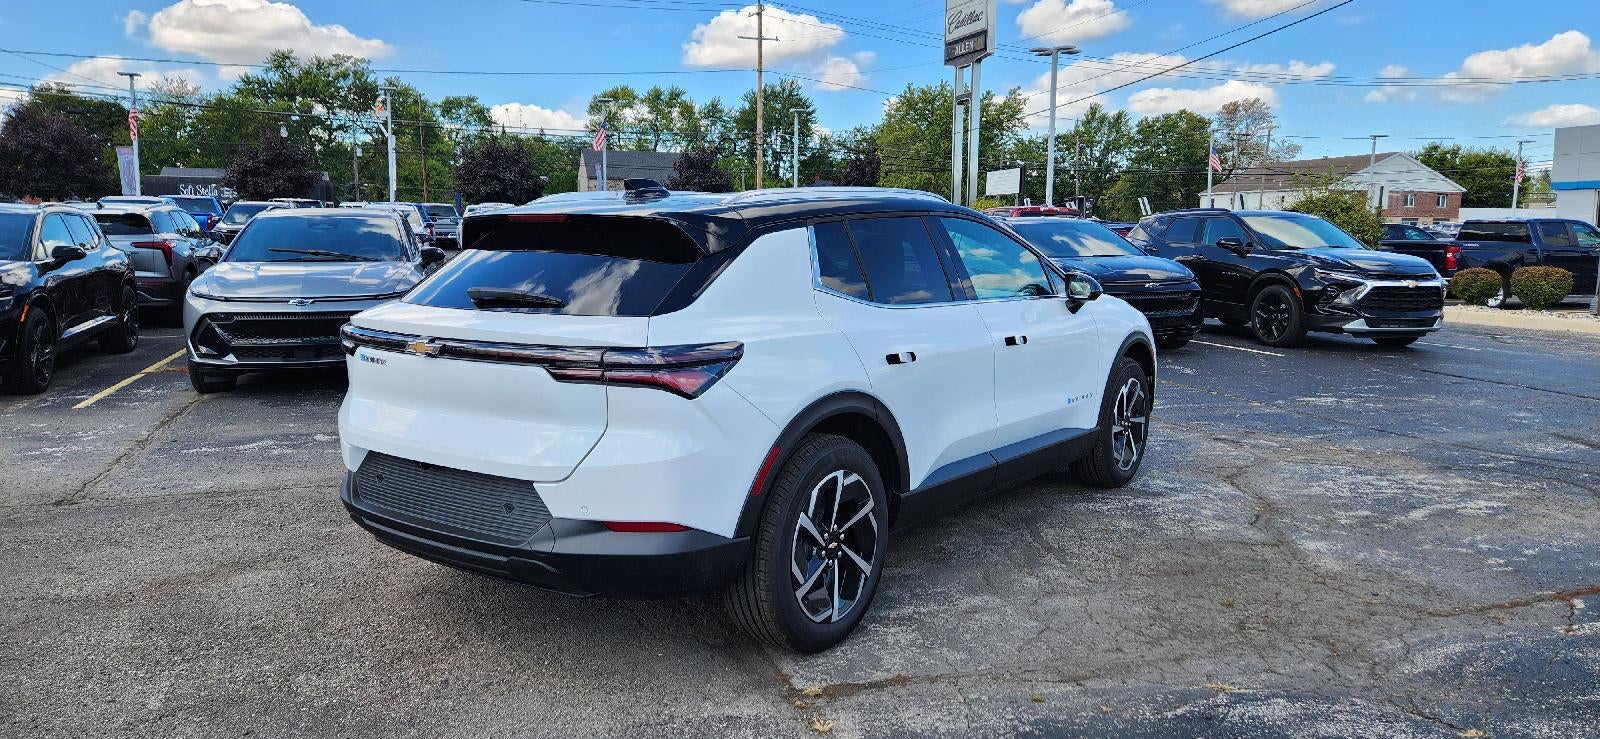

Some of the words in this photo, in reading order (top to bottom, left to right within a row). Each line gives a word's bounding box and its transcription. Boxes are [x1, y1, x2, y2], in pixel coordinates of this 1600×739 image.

[947, 10, 984, 34] Cadillac
[954, 40, 974, 56] ALLEN
[180, 184, 194, 196] Soft
